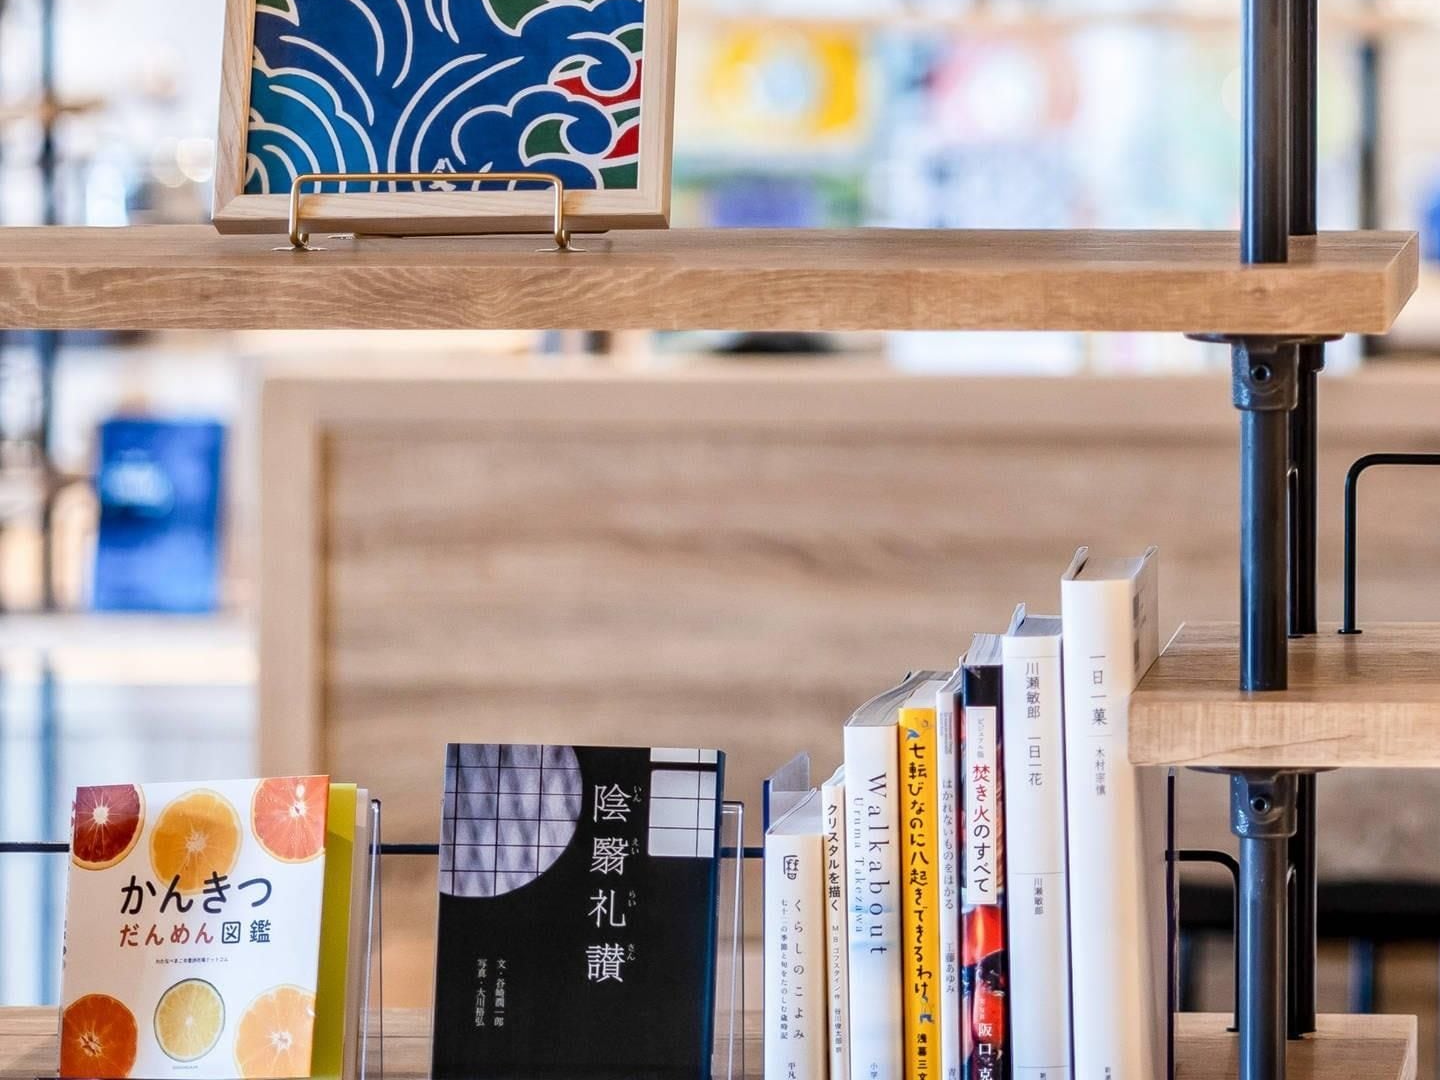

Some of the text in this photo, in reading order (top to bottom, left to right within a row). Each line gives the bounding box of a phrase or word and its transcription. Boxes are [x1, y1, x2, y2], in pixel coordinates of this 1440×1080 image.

[1026, 662, 1043, 787] 川瀬敏郎 一日一花
[1089, 655, 1108, 726] 一日一菓
[828, 804, 841, 911] クリスタルを描く
[868, 772, 890, 954] Walkabout
[908, 743, 932, 998] 七転びなのに八起きできるわけ
[942, 779, 954, 910] はかれないものをはかる
[972, 764, 991, 893] 焚き火のすべて
[119, 919, 271, 947] だんめん図鑑
[120, 871, 272, 915] かんきつ
[793, 899, 805, 1040] くらしのこよみ
